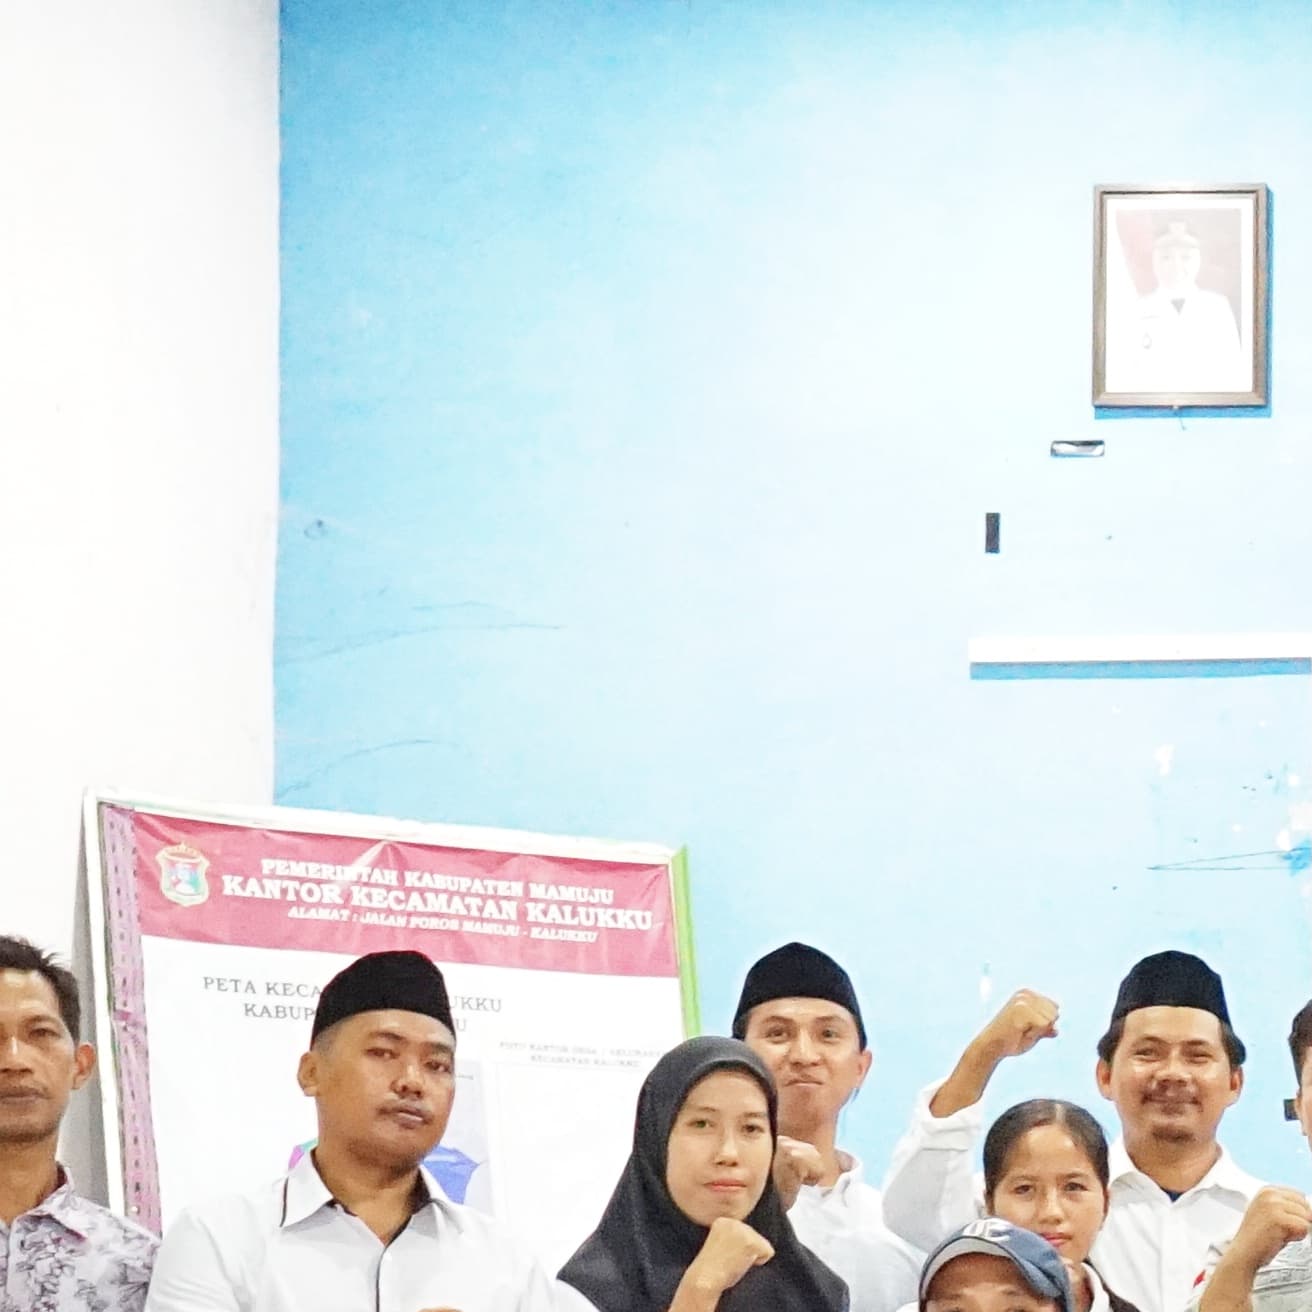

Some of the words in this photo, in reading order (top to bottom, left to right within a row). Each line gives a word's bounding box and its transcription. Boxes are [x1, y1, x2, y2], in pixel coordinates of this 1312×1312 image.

[221, 874, 345, 905] KANTOR
[350, 885, 518, 921] KECAMATAN
[525, 901, 654, 931] KALUKKU
[260, 858, 399, 886] PEMERINTAH
[404, 870, 524, 897] KABUPATEN
[529, 882, 614, 905] MAMUJU
[287, 906, 351, 922] ALAMAT
[359, 912, 407, 928] JALAN
[409, 916, 460, 931] POROS
[462, 920, 521, 937] MAMUJU
[529, 929, 599, 943] KALUKKU
[203, 976, 256, 995] PETA
